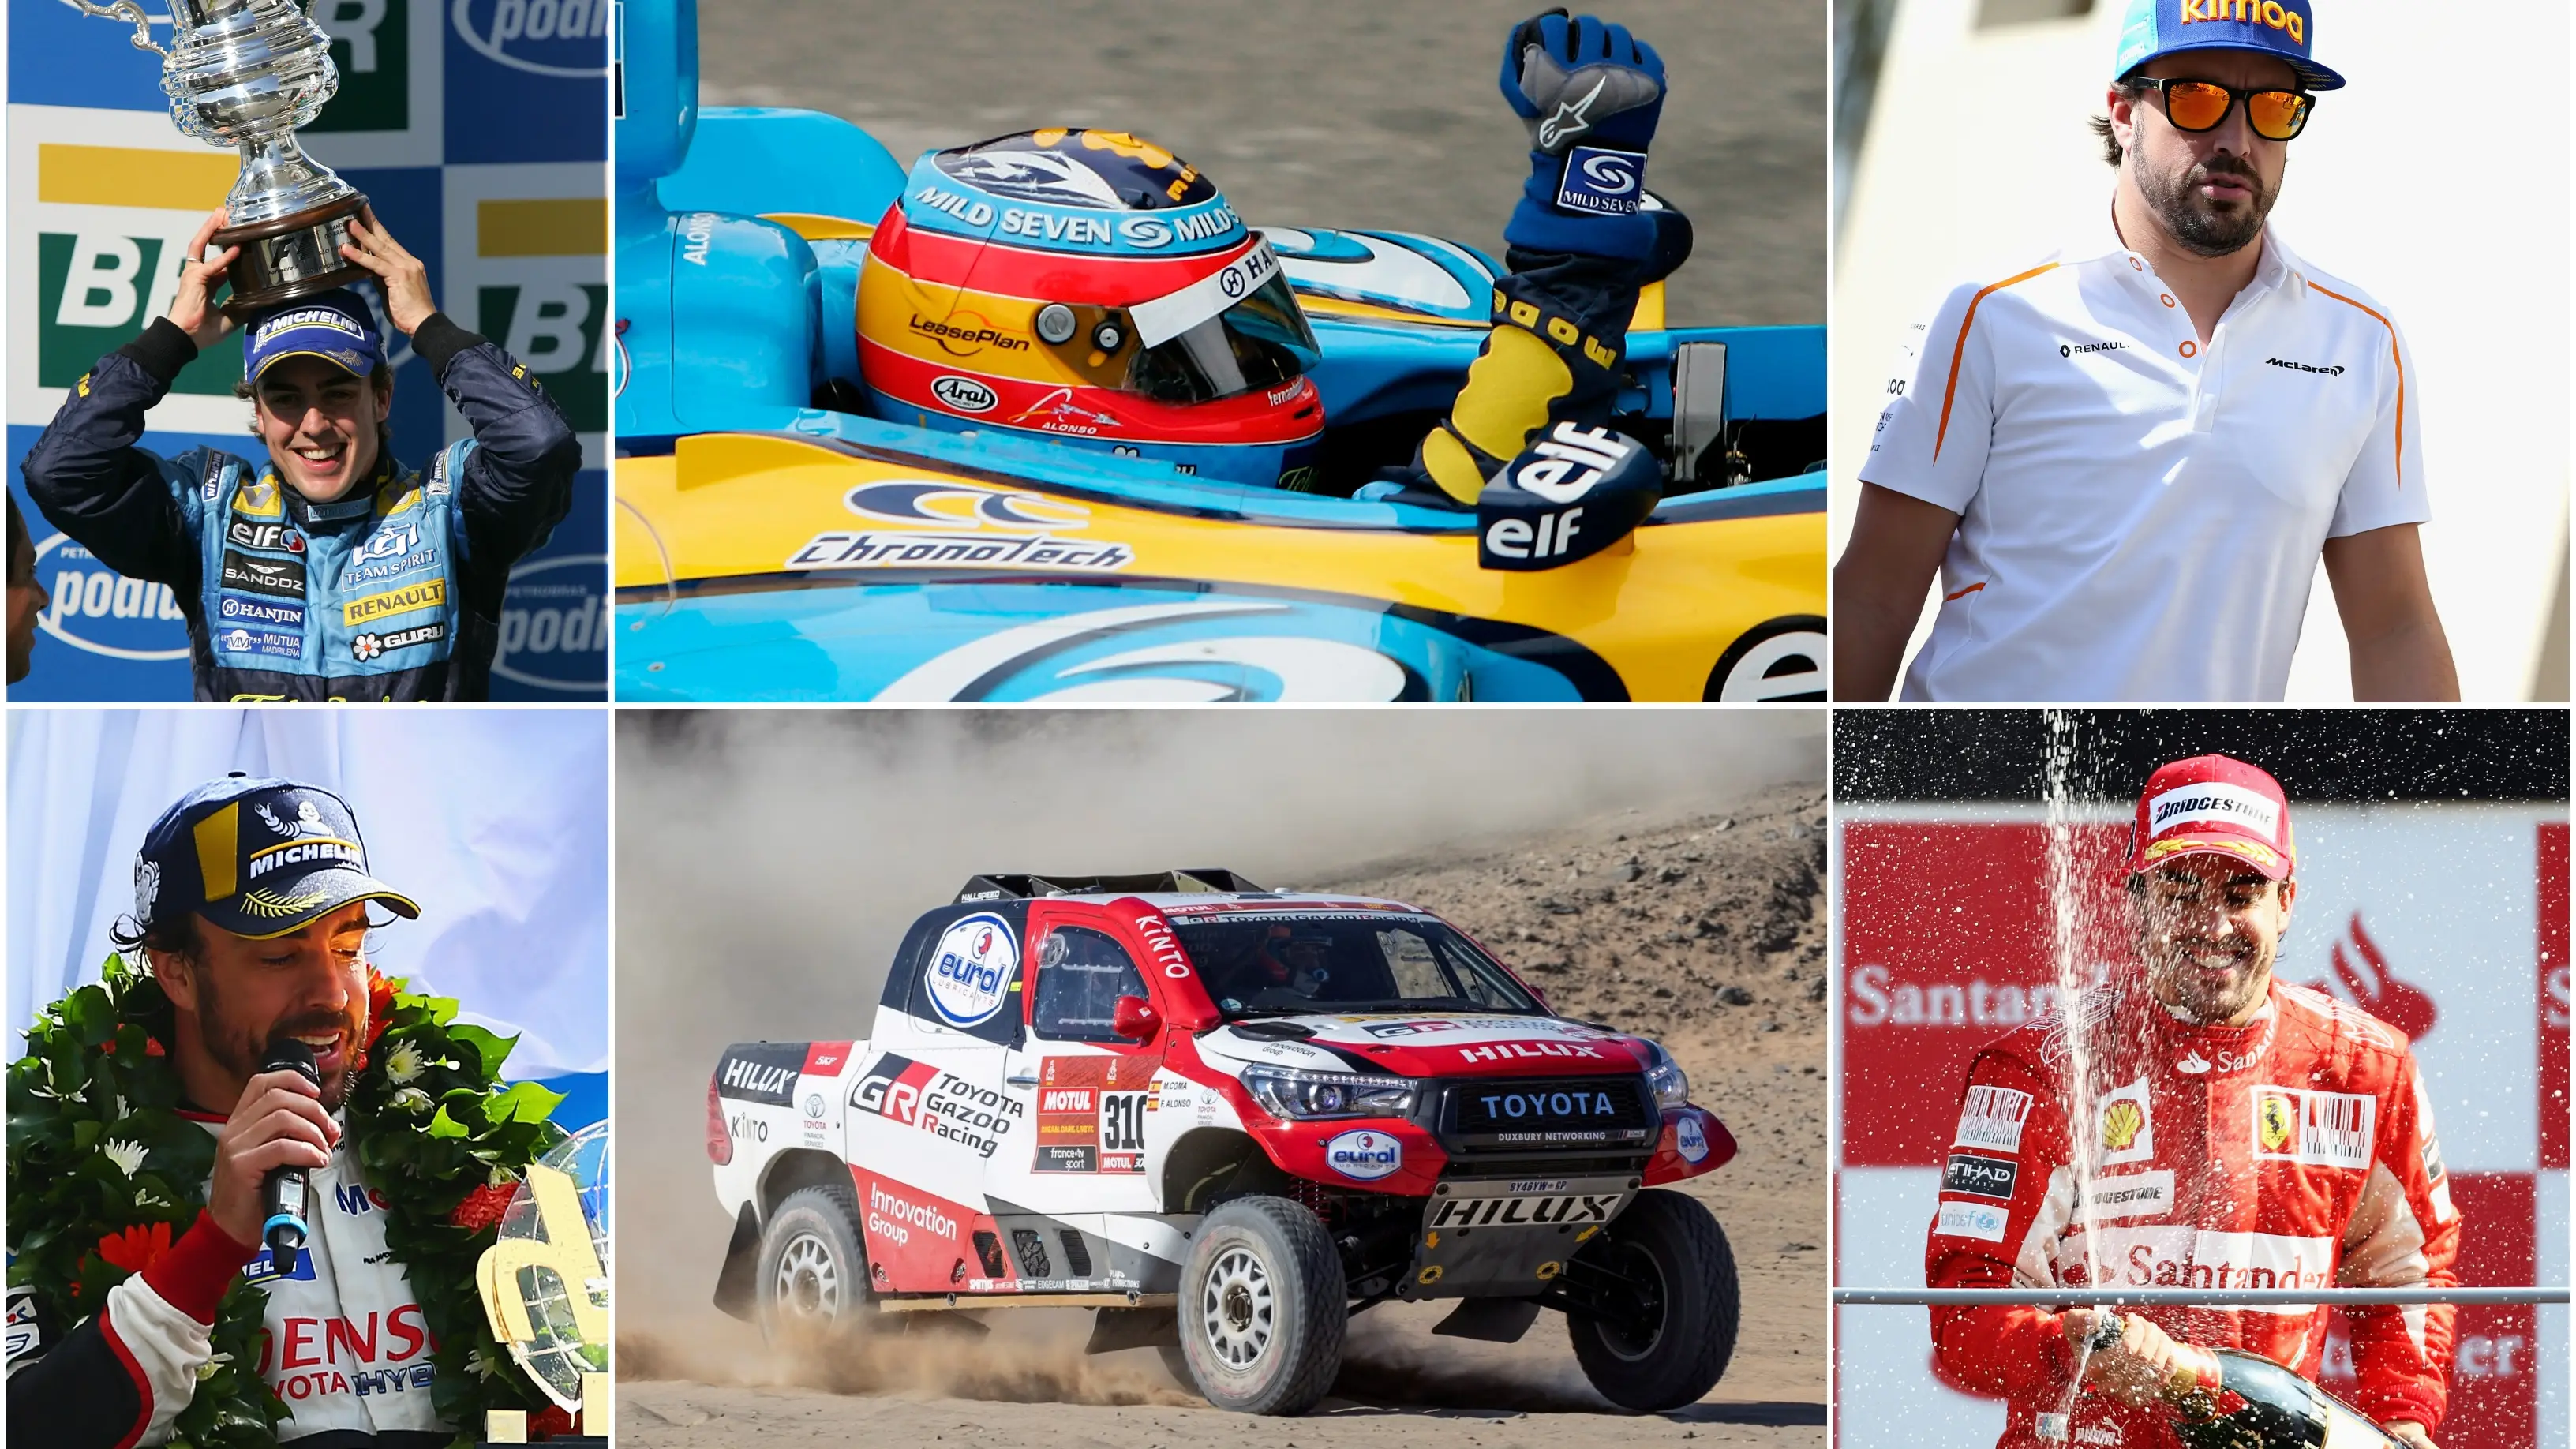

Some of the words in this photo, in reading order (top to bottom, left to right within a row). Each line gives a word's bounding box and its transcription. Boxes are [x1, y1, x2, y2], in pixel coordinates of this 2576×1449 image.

[2181, 0, 2303, 46] kimoa
[314, 0, 387, 72] R
[1563, 190, 1599, 208] MILD
[1601, 199, 1638, 213] SEVEN
[915, 186, 993, 227] MILD
[1002, 208, 1113, 244] SEVEN
[1174, 208, 1231, 242] MILD
[271, 310, 358, 332] MICHELIN
[909, 314, 1031, 352] LeasePlan
[2074, 342, 2129, 354] RENAUL
[2265, 358, 2346, 378] McLaren
[942, 380, 987, 405] Arai
[1041, 421, 1098, 436] ALONSO
[1517, 421, 1631, 504] elf
[232, 522, 282, 547] elf
[1486, 507, 1584, 559] elf
[791, 534, 1132, 568] ChronoTech
[225, 567, 304, 592] SANDOZ
[345, 563, 388, 586] TEAM
[390, 549, 436, 575] SPIRIT
[239, 603, 302, 623] HANJIN
[350, 584, 442, 620] RENAULT
[263, 633, 300, 649] MUTUA
[383, 626, 444, 649] GURU
[250, 844, 361, 879] MICHELIN
[961, 890, 1000, 902] HALLSPEED
[1163, 905, 1214, 914] MOTUL
[938, 951, 1007, 997] eurol
[815, 1055, 838, 1065] SKF
[1459, 1043, 1605, 1064] HILUX
[723, 1058, 798, 1095] HILUX
[852, 1074, 919, 1124] GR
[939, 1073, 1024, 1118] TOYOTA
[1043, 1091, 1091, 1110] MOTUL
[1166, 1099, 1192, 1108] ALONSO
[1481, 1092, 1615, 1118] TOYOTA
[803, 1120, 827, 1130] TOYOTA
[926, 1092, 1011, 1135] GAZOO
[921, 1112, 999, 1159] Racing
[1545, 1132, 1606, 1141] NETWORKING
[1065, 1159, 1085, 1172] sport
[1103, 1155, 1132, 1169] MOTUL
[1334, 1147, 1396, 1164] eurol
[1947, 1162, 2012, 1182] ETIHAD
[1432, 1195, 1620, 1226] HILUX
[1941, 1211, 1977, 1228] unicef
[869, 1211, 908, 1247] Group
[1038, 1280, 1065, 1289] EDGECAM
